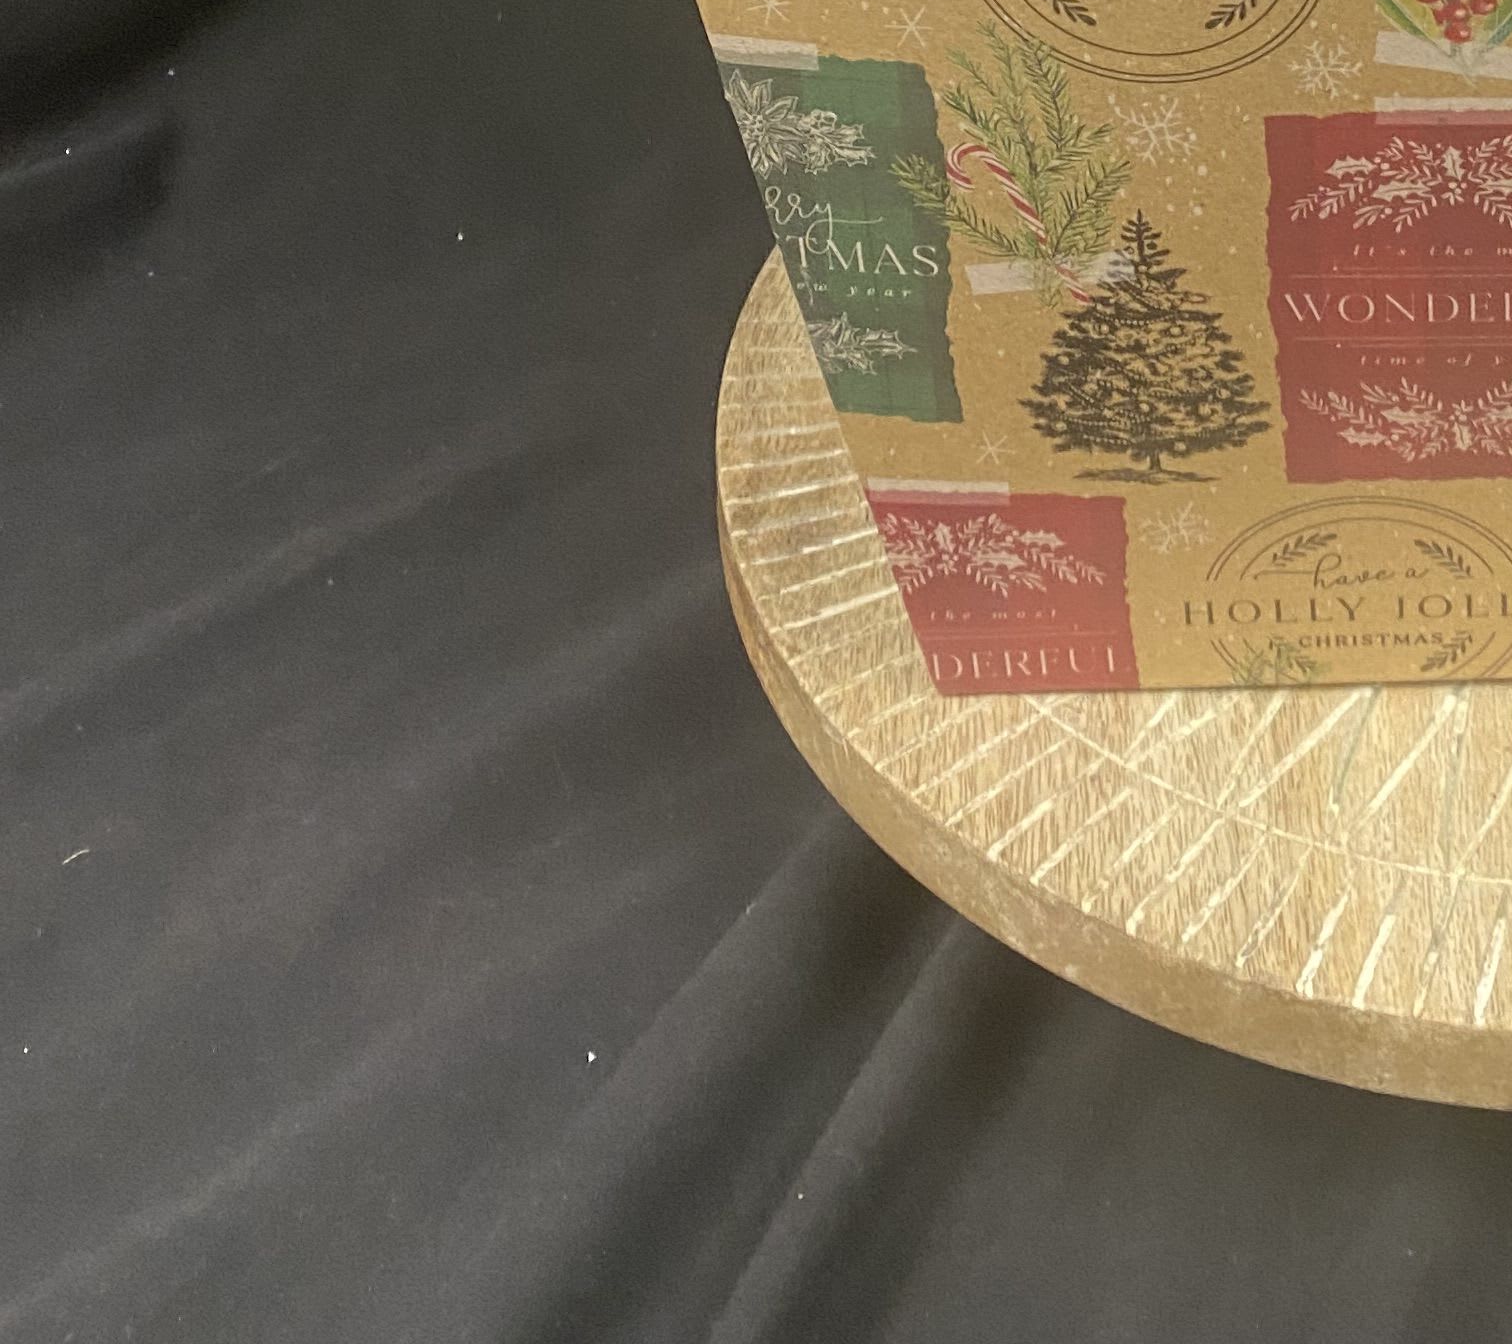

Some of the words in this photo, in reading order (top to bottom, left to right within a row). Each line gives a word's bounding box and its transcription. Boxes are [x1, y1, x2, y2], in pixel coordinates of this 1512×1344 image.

[1429, 244, 1474, 257] the
[848, 286, 912, 297] year
[1361, 354, 1425, 367] time
[1253, 553, 1397, 592] have
[1183, 595, 1366, 627] HOLLY
[1299, 630, 1446, 649] CHRISTMAS
[933, 645, 1132, 682] DERFUL
